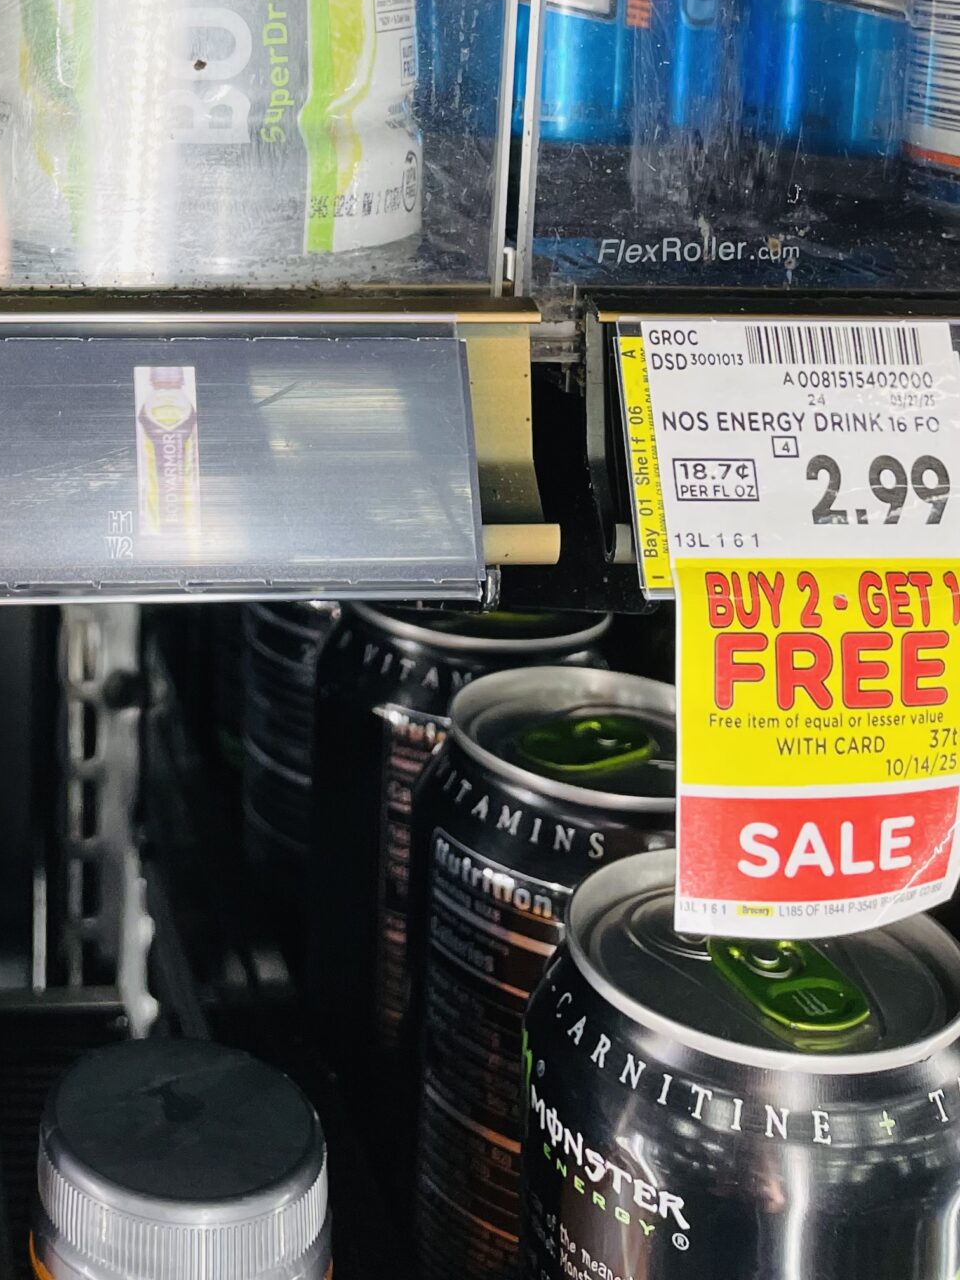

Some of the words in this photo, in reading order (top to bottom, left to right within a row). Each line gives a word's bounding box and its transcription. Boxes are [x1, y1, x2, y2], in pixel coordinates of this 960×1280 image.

[598, 237, 799, 266] FlexRoller.com
[649, 330, 698, 346] GROC
[651, 353, 687, 371] DSD
[690, 354, 744, 367] 3001013
[807, 393, 826, 407] 24
[628, 405, 644, 425] 06
[662, 411, 709, 432] NOS
[718, 411, 805, 432] ENERGY
[814, 412, 884, 432] DRINK
[888, 416, 907, 432] 16
[915, 416, 940, 433] FO
[631, 436, 650, 486] Shelf
[781, 442, 791, 453] 4
[678, 463, 750, 481] 18.7¢
[680, 485, 708, 498] PER
[713, 485, 730, 498] FL
[735, 485, 756, 498] OZ
[805, 454, 951, 525] 2.99
[639, 499, 654, 516] 01
[644, 528, 661, 558] Bay
[674, 533, 709, 549] 13L
[733, 533, 744, 548] 6
[705, 571, 785, 629] BUY
[796, 570, 822, 628] 2
[858, 570, 933, 628] GET
[943, 570, 960, 627] 1
[363, 644, 474, 690] VITAM
[714, 630, 950, 711] FREE
[709, 714, 742, 728] Free
[748, 713, 779, 727] item
[786, 713, 800, 728] of
[805, 713, 843, 731] equal
[848, 716, 862, 727] or
[868, 711, 906, 726] lesser
[911, 710, 944, 724] value
[776, 737, 827, 755] WITH
[834, 736, 886, 754] CARD
[929, 728, 958, 748] 37t
[885, 753, 957, 778] 10/14/25
[442, 770, 606, 860] ITAMINS
[737, 815, 916, 879] SALE
[806, 904, 820, 915] OF
[555, 992, 833, 1146] CARNITINE
[531, 1084, 691, 1230] MONSTER
[543, 1144, 656, 1237] ENERGY
[560, 1222, 577, 1254] the
